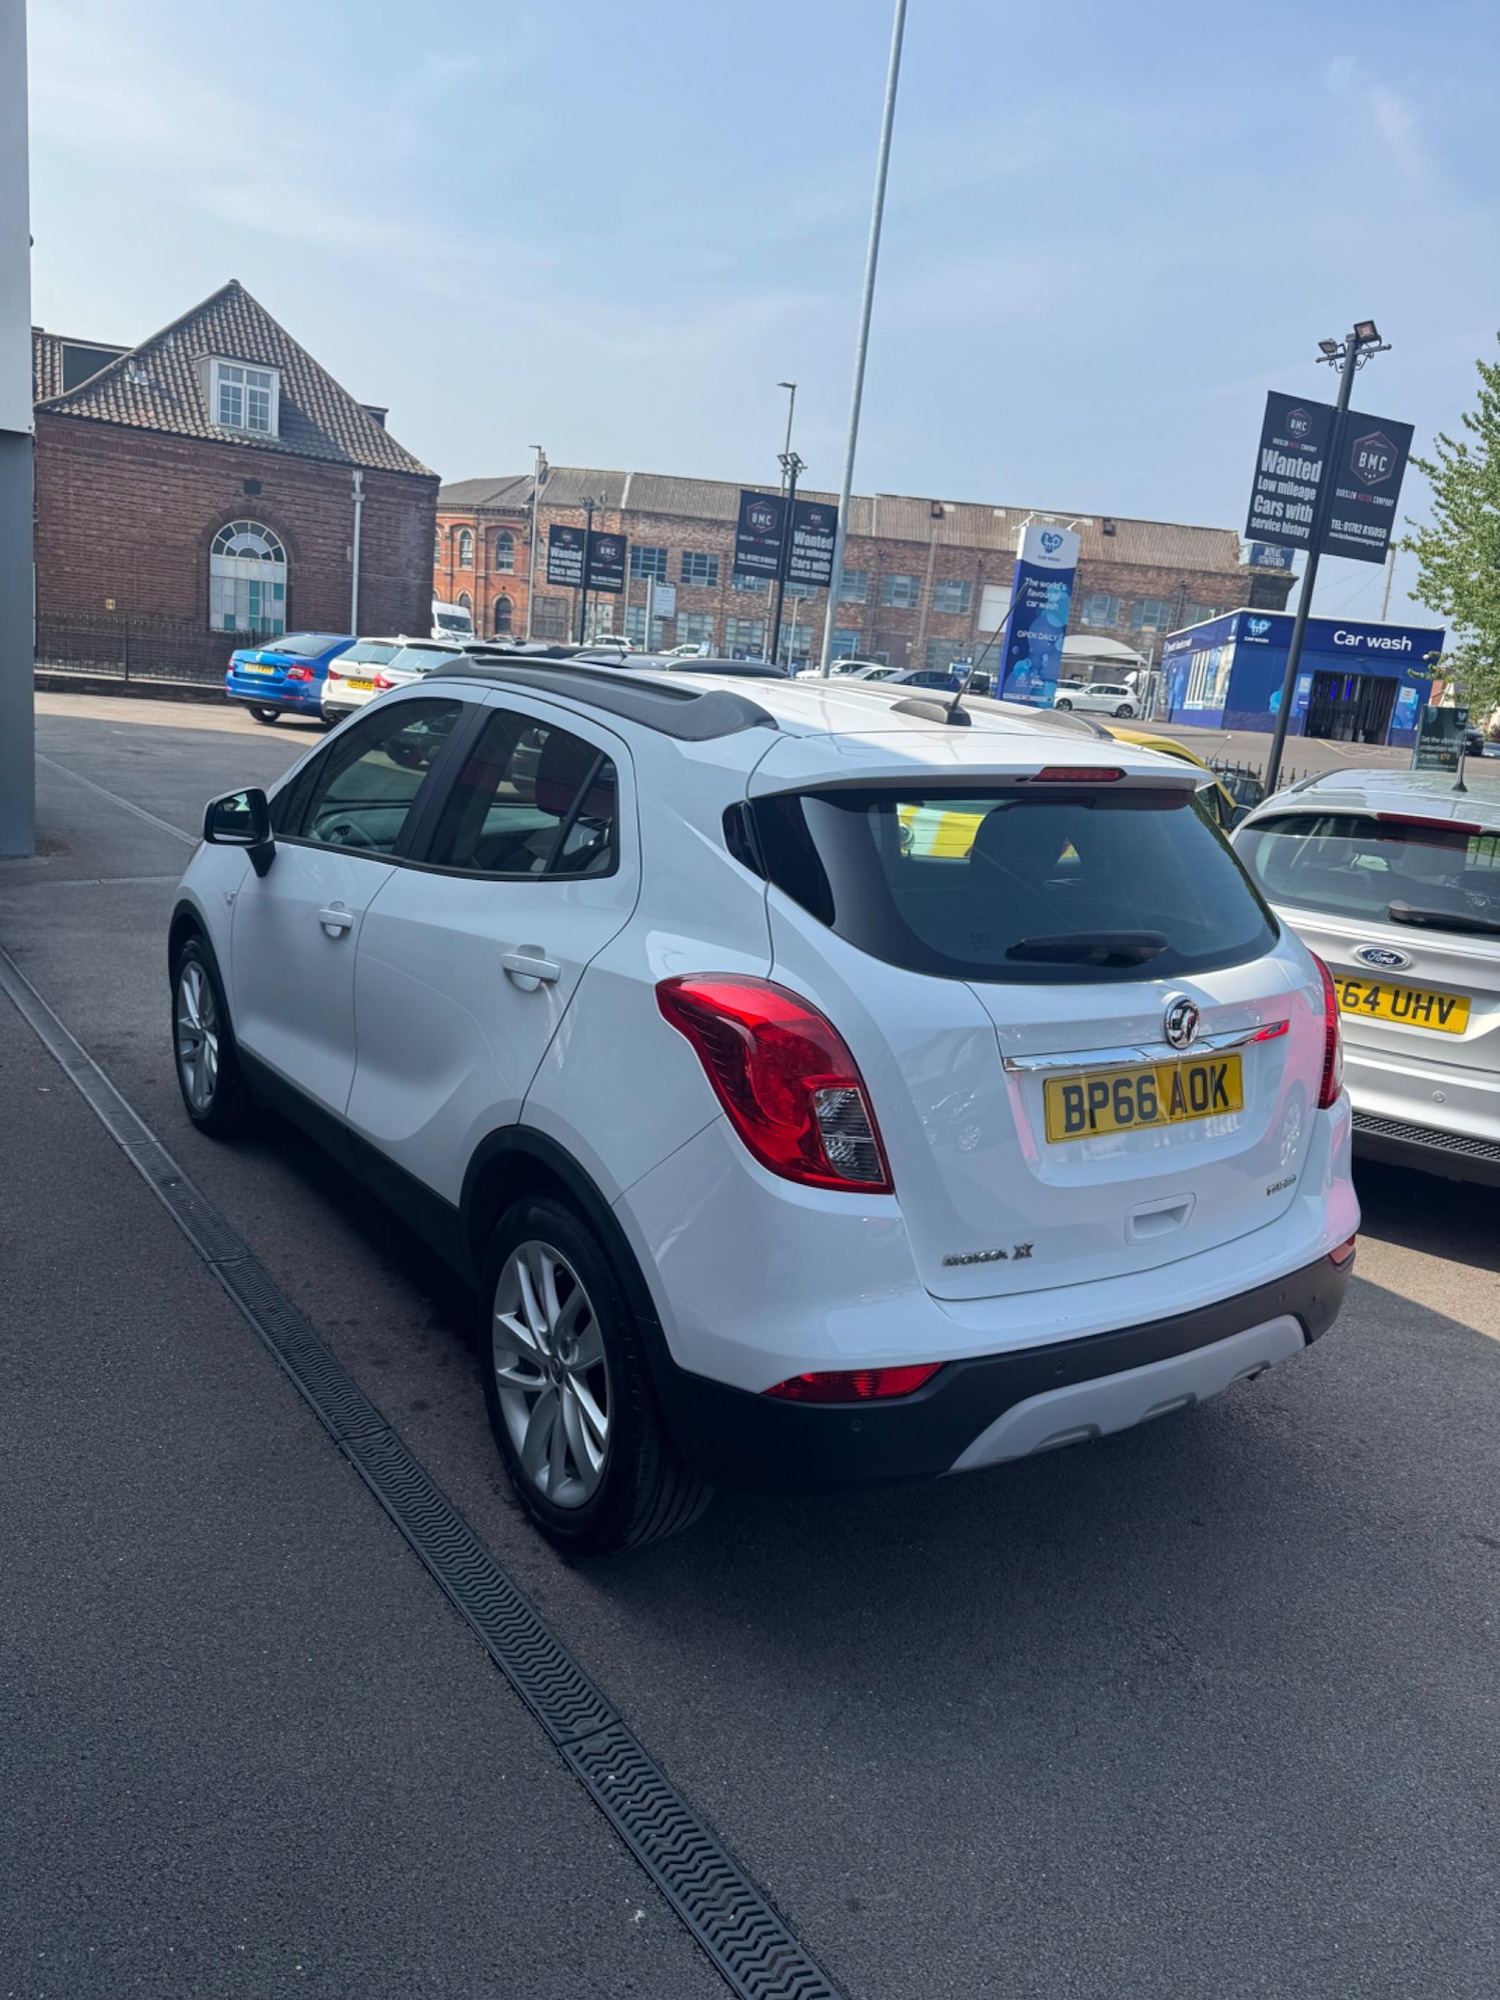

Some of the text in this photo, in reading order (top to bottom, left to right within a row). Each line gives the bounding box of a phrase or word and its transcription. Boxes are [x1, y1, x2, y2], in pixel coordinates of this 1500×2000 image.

[1290, 418, 1308, 431] BMC
[1261, 448, 1323, 483] Wanted
[1358, 451, 1388, 472] BMC
[1257, 475, 1317, 501] Low mileage
[1253, 494, 1314, 523] Cars with
[1250, 517, 1281, 532] service
[1281, 521, 1311, 539] history
[794, 530, 835, 550] Wanted
[791, 556, 811, 570] Cars
[811, 560, 831, 572] with
[1025, 577, 1067, 591] The world's
[1025, 600, 1060, 610] car wash
[1016, 630, 1058, 642] OPEN DAILY
[1333, 630, 1413, 651] Car wash
[1367, 950, 1397, 965] Ford
[1390, 989, 1457, 1026] UHV
[1062, 1063, 1229, 1133] BP66 AOK
[1012, 1242, 1034, 1260] X
